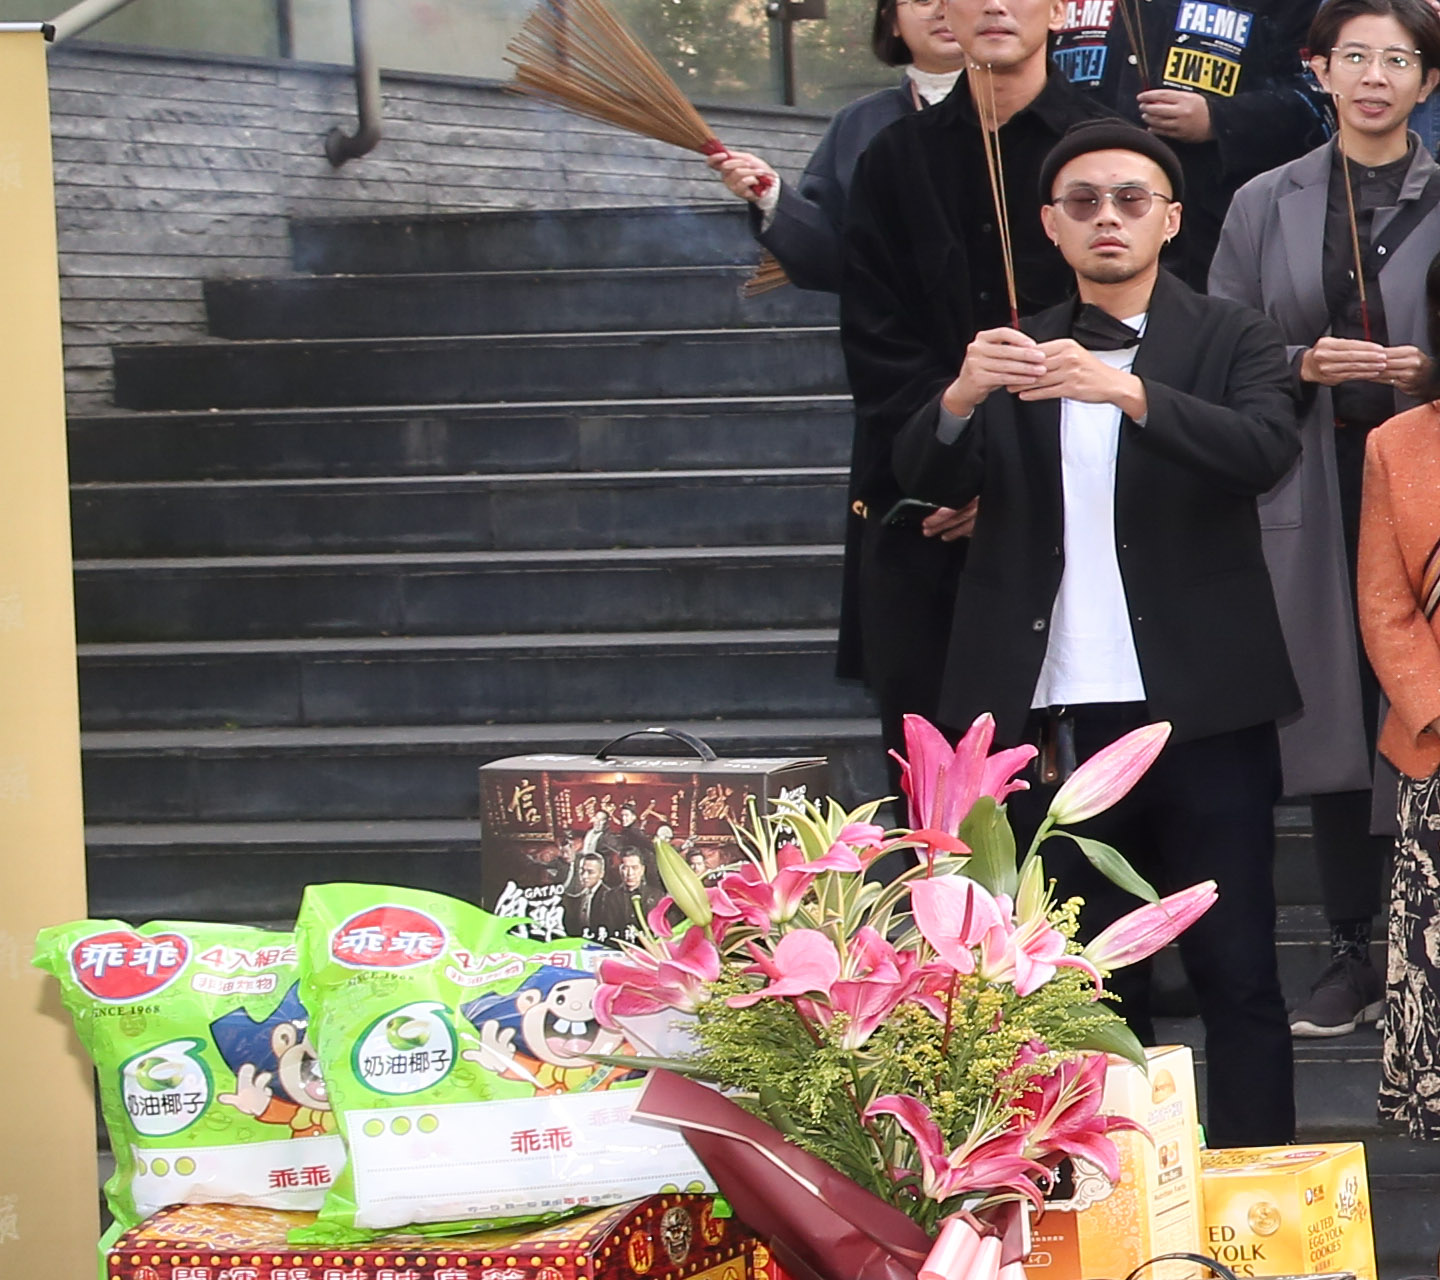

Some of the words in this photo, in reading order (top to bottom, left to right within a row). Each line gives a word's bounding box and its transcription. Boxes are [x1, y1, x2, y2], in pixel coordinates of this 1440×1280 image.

[1179, 2, 1250, 45] FA:ME
[339, 926, 436, 954] 乖乖
[80, 941, 180, 977] 乖乖
[363, 1049, 450, 1078] 奶油椰子
[269, 1165, 331, 1189] 乖乖
[1307, 1215, 1334, 1237] SALTED
[1308, 1231, 1324, 1250] EGG
[1325, 1226, 1344, 1245] YOLK
[1208, 1244, 1266, 1261] YOLK
[1310, 1241, 1342, 1263] COOKIES
